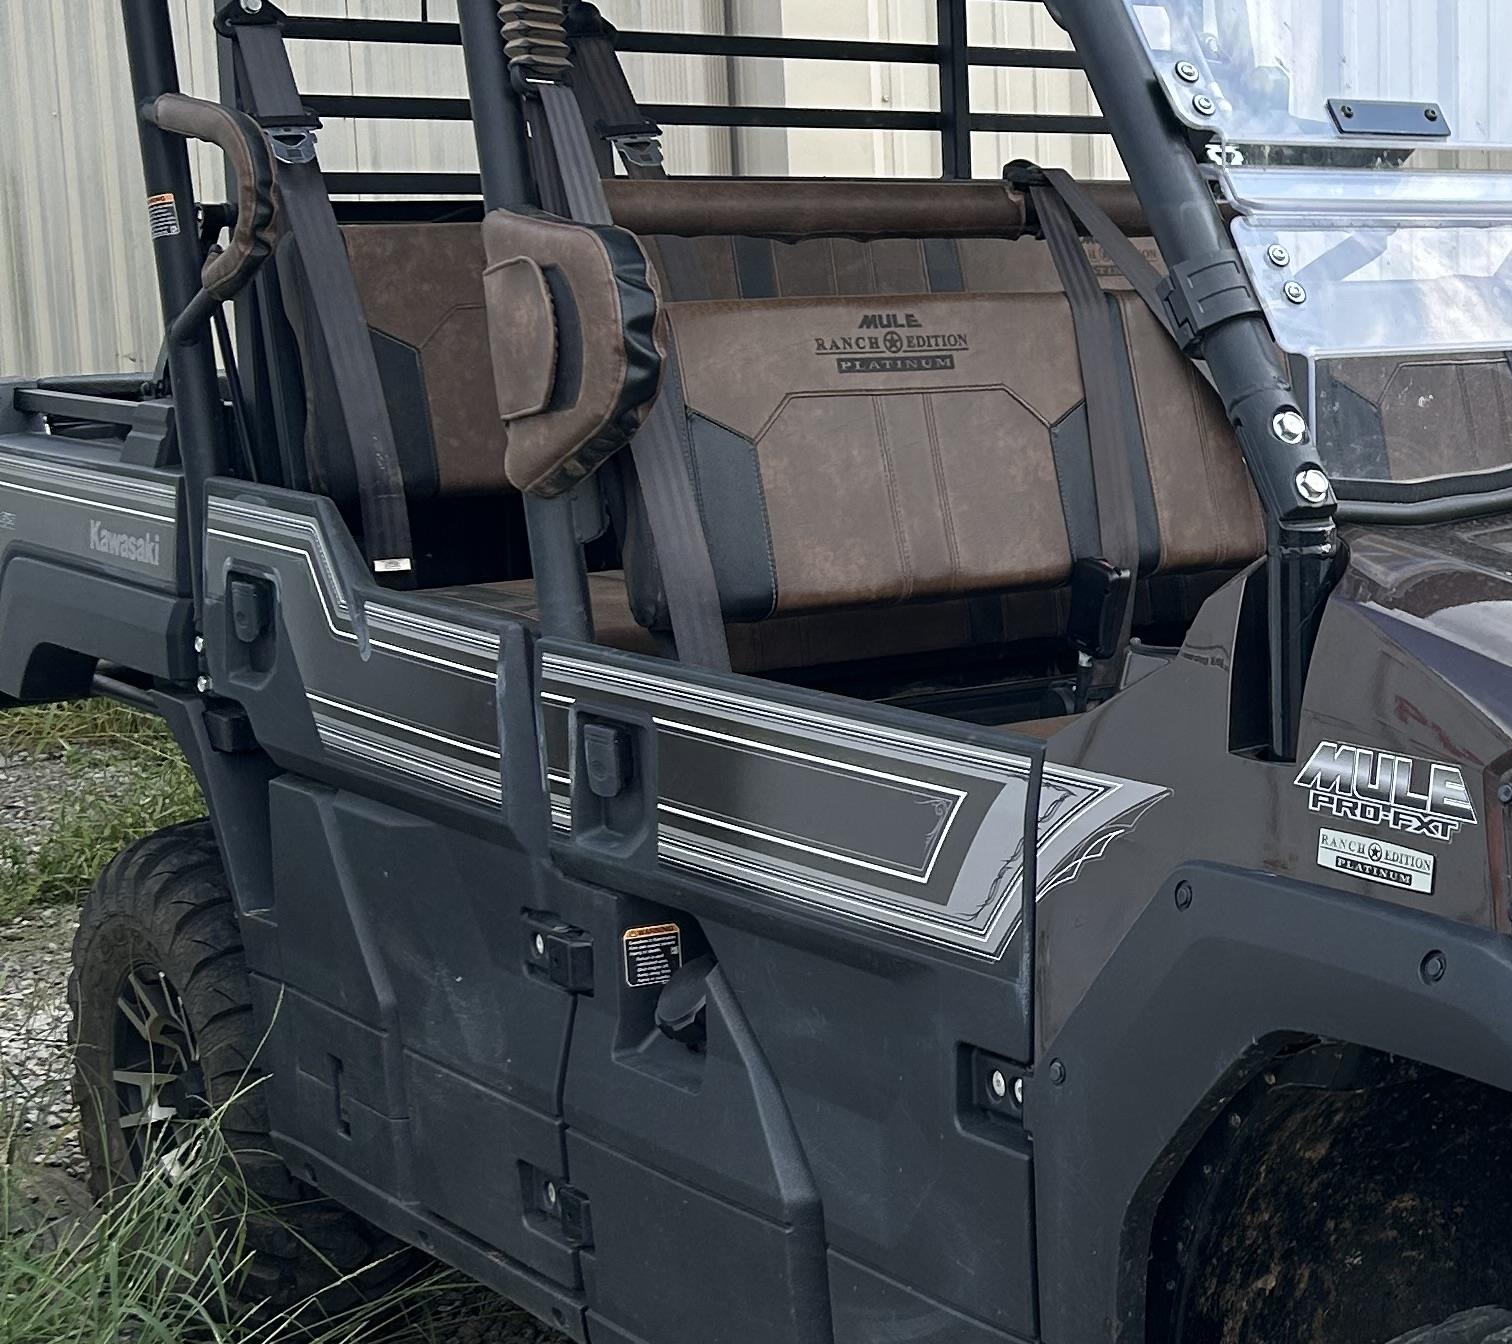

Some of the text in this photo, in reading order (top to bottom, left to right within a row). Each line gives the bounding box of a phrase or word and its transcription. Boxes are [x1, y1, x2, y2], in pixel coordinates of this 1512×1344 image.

[858, 314, 922, 329] MULE
[815, 334, 968, 351] RANCH EDITION
[839, 357, 952, 372] PLATINUM
[90, 520, 160, 565] Kawasaki
[1294, 740, 1478, 824] MULE
[1309, 789, 1460, 841] PRO-FXT
[1321, 833, 1431, 872] RANCH EDITION
[1337, 856, 1412, 885] PLATINUM
